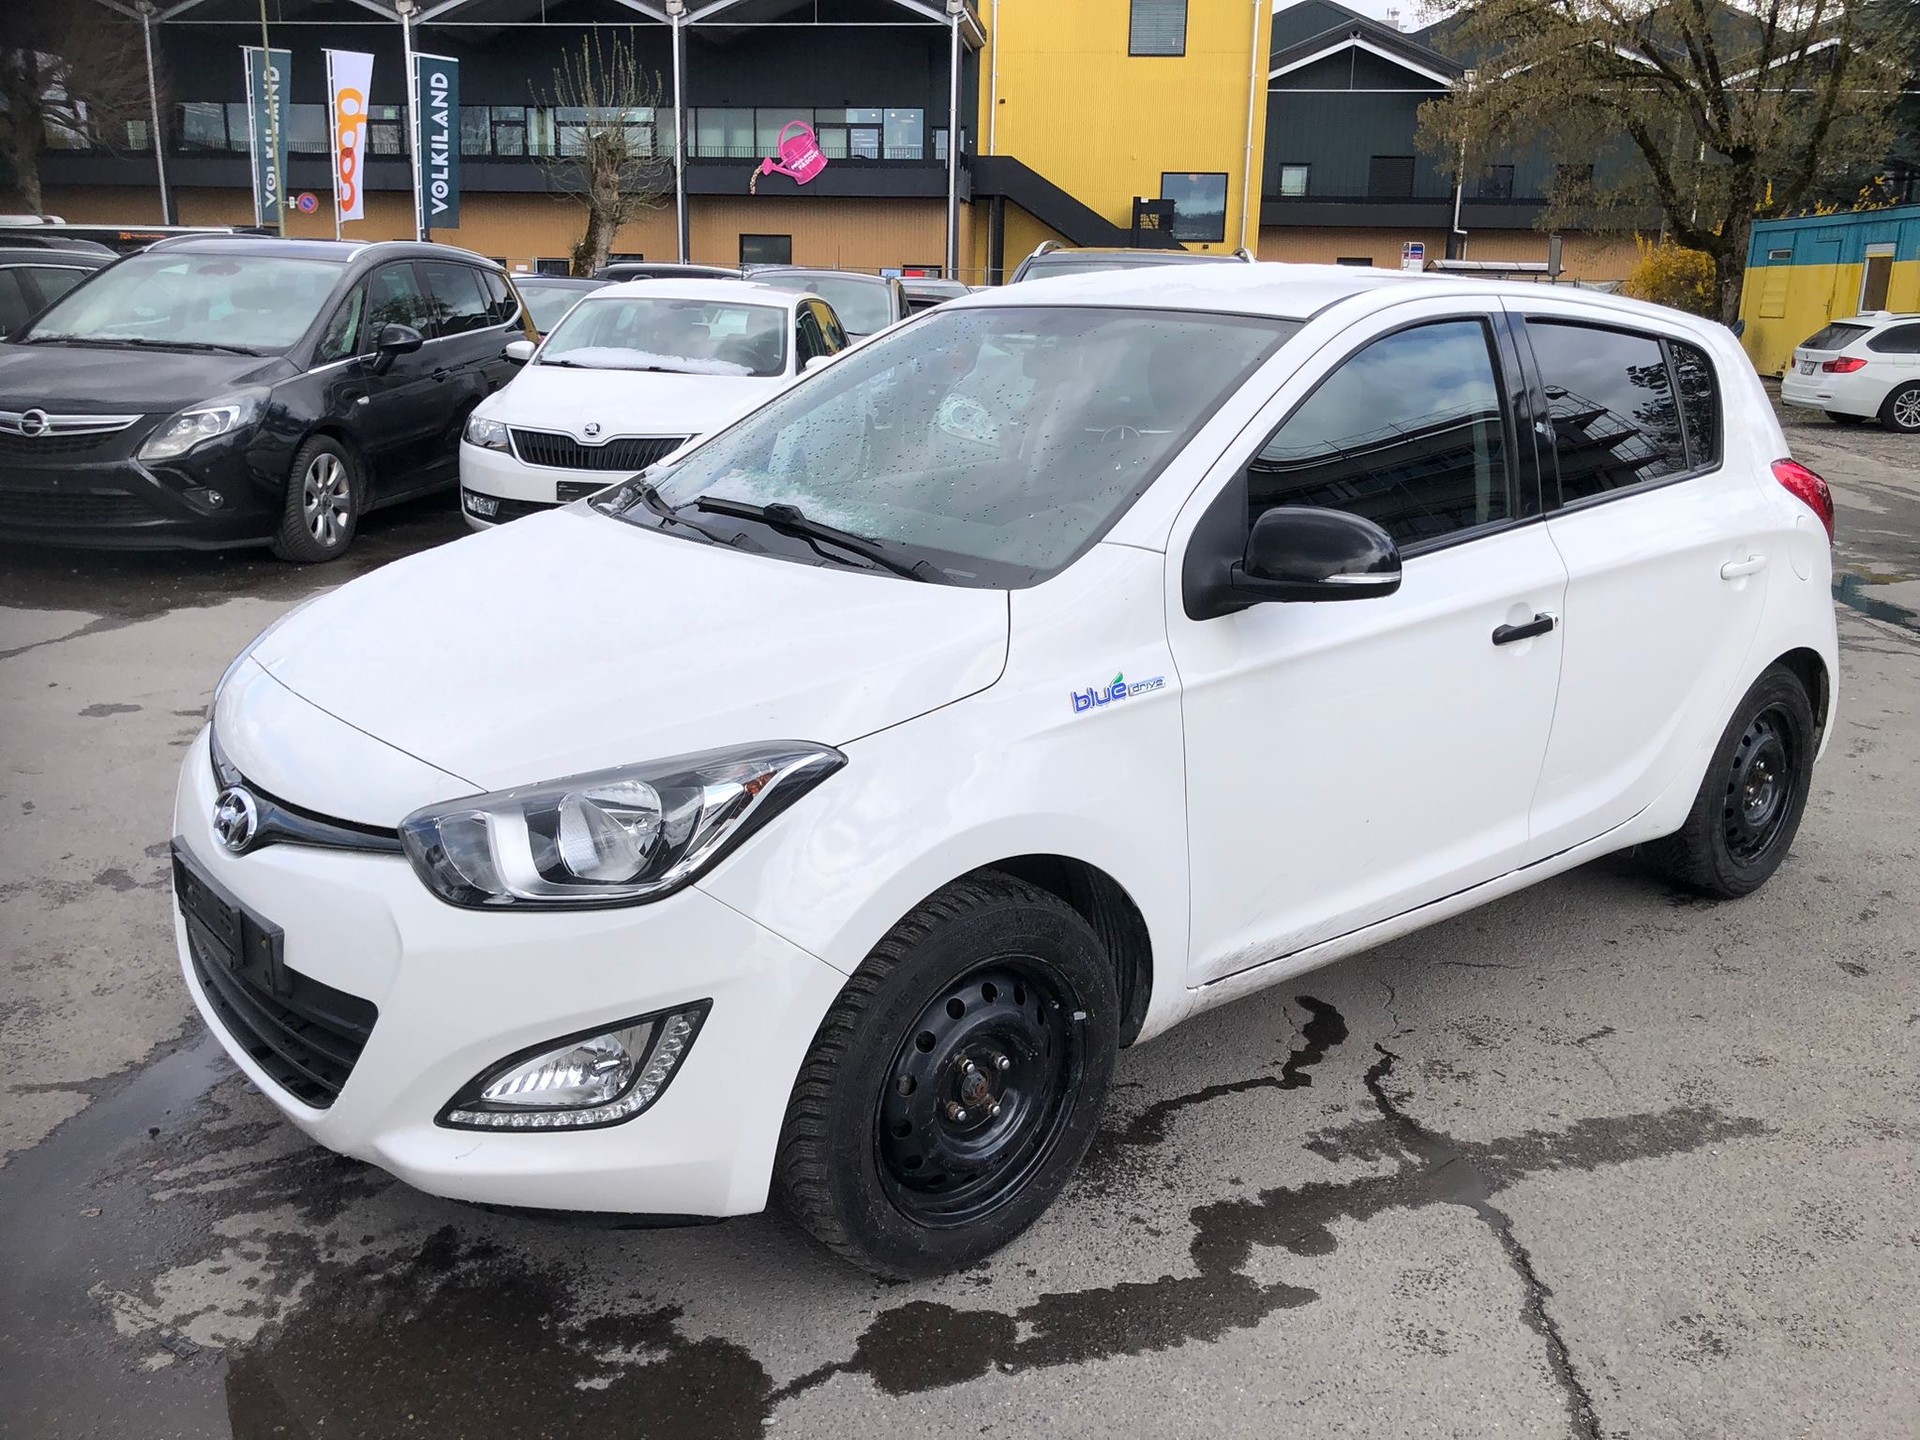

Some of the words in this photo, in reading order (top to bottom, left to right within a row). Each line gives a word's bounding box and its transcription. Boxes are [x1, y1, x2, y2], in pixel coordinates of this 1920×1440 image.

[337, 87, 367, 212] coop
[430, 72, 449, 215] VOLKILAND
[1071, 681, 1127, 713] blue
[1132, 679, 1164, 693] drive
